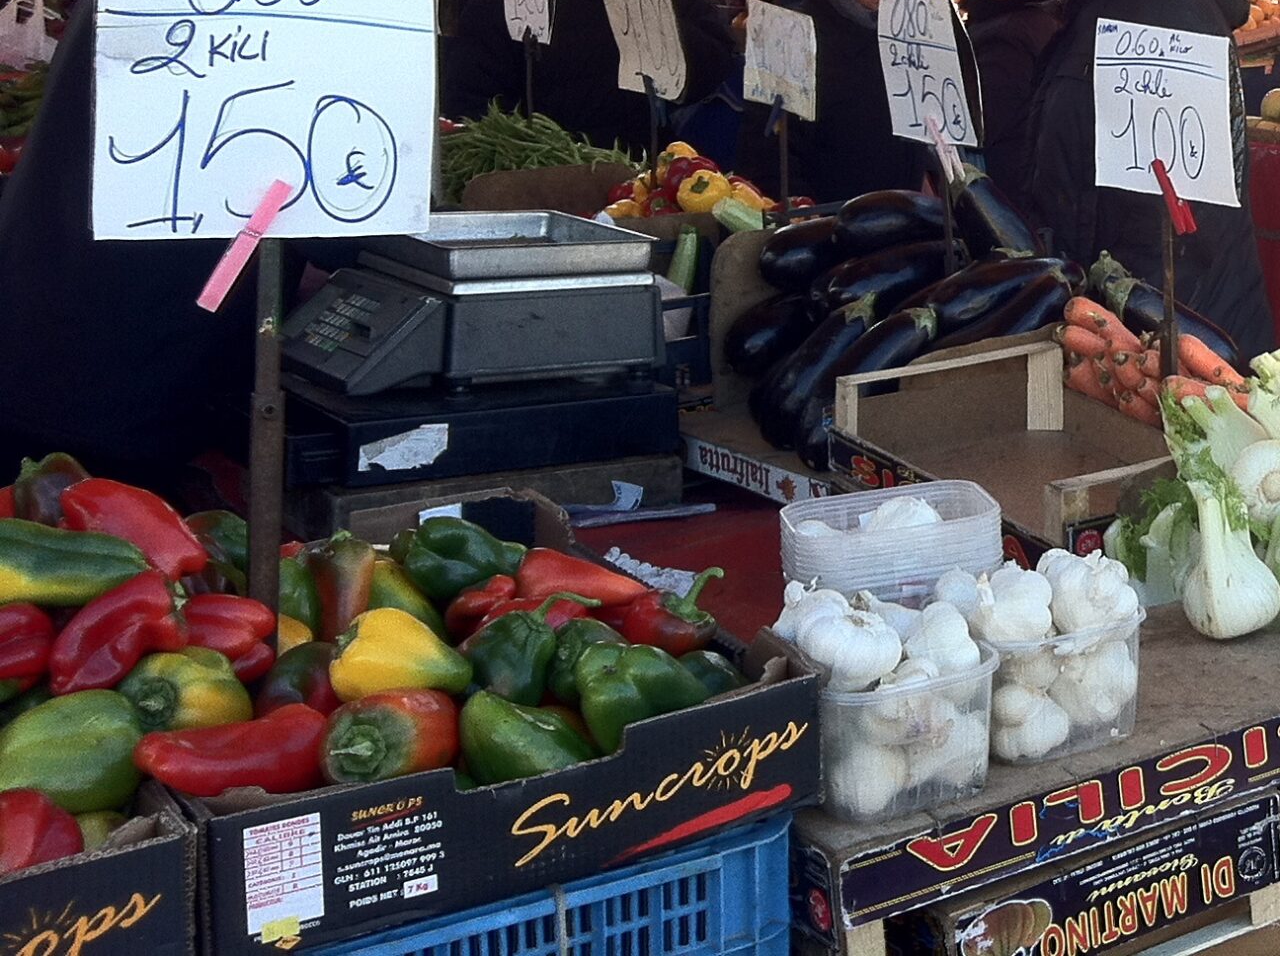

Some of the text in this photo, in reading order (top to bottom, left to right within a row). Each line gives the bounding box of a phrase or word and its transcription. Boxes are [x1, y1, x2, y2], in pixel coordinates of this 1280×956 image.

[130, 19, 207, 78] 2
[889, 43, 902, 68] 2
[1113, 66, 1134, 95] 2
[699, 444, 771, 496] Italfrutta
[350, 796, 423, 822] SUNCROPS
[511, 721, 809, 868] Suncrops
[348, 875, 387, 893] STATION
[1085, 852, 1201, 902] Giovanni
[1200, 855, 1235, 904] DI
[1040, 872, 1189, 956] MARTINO
